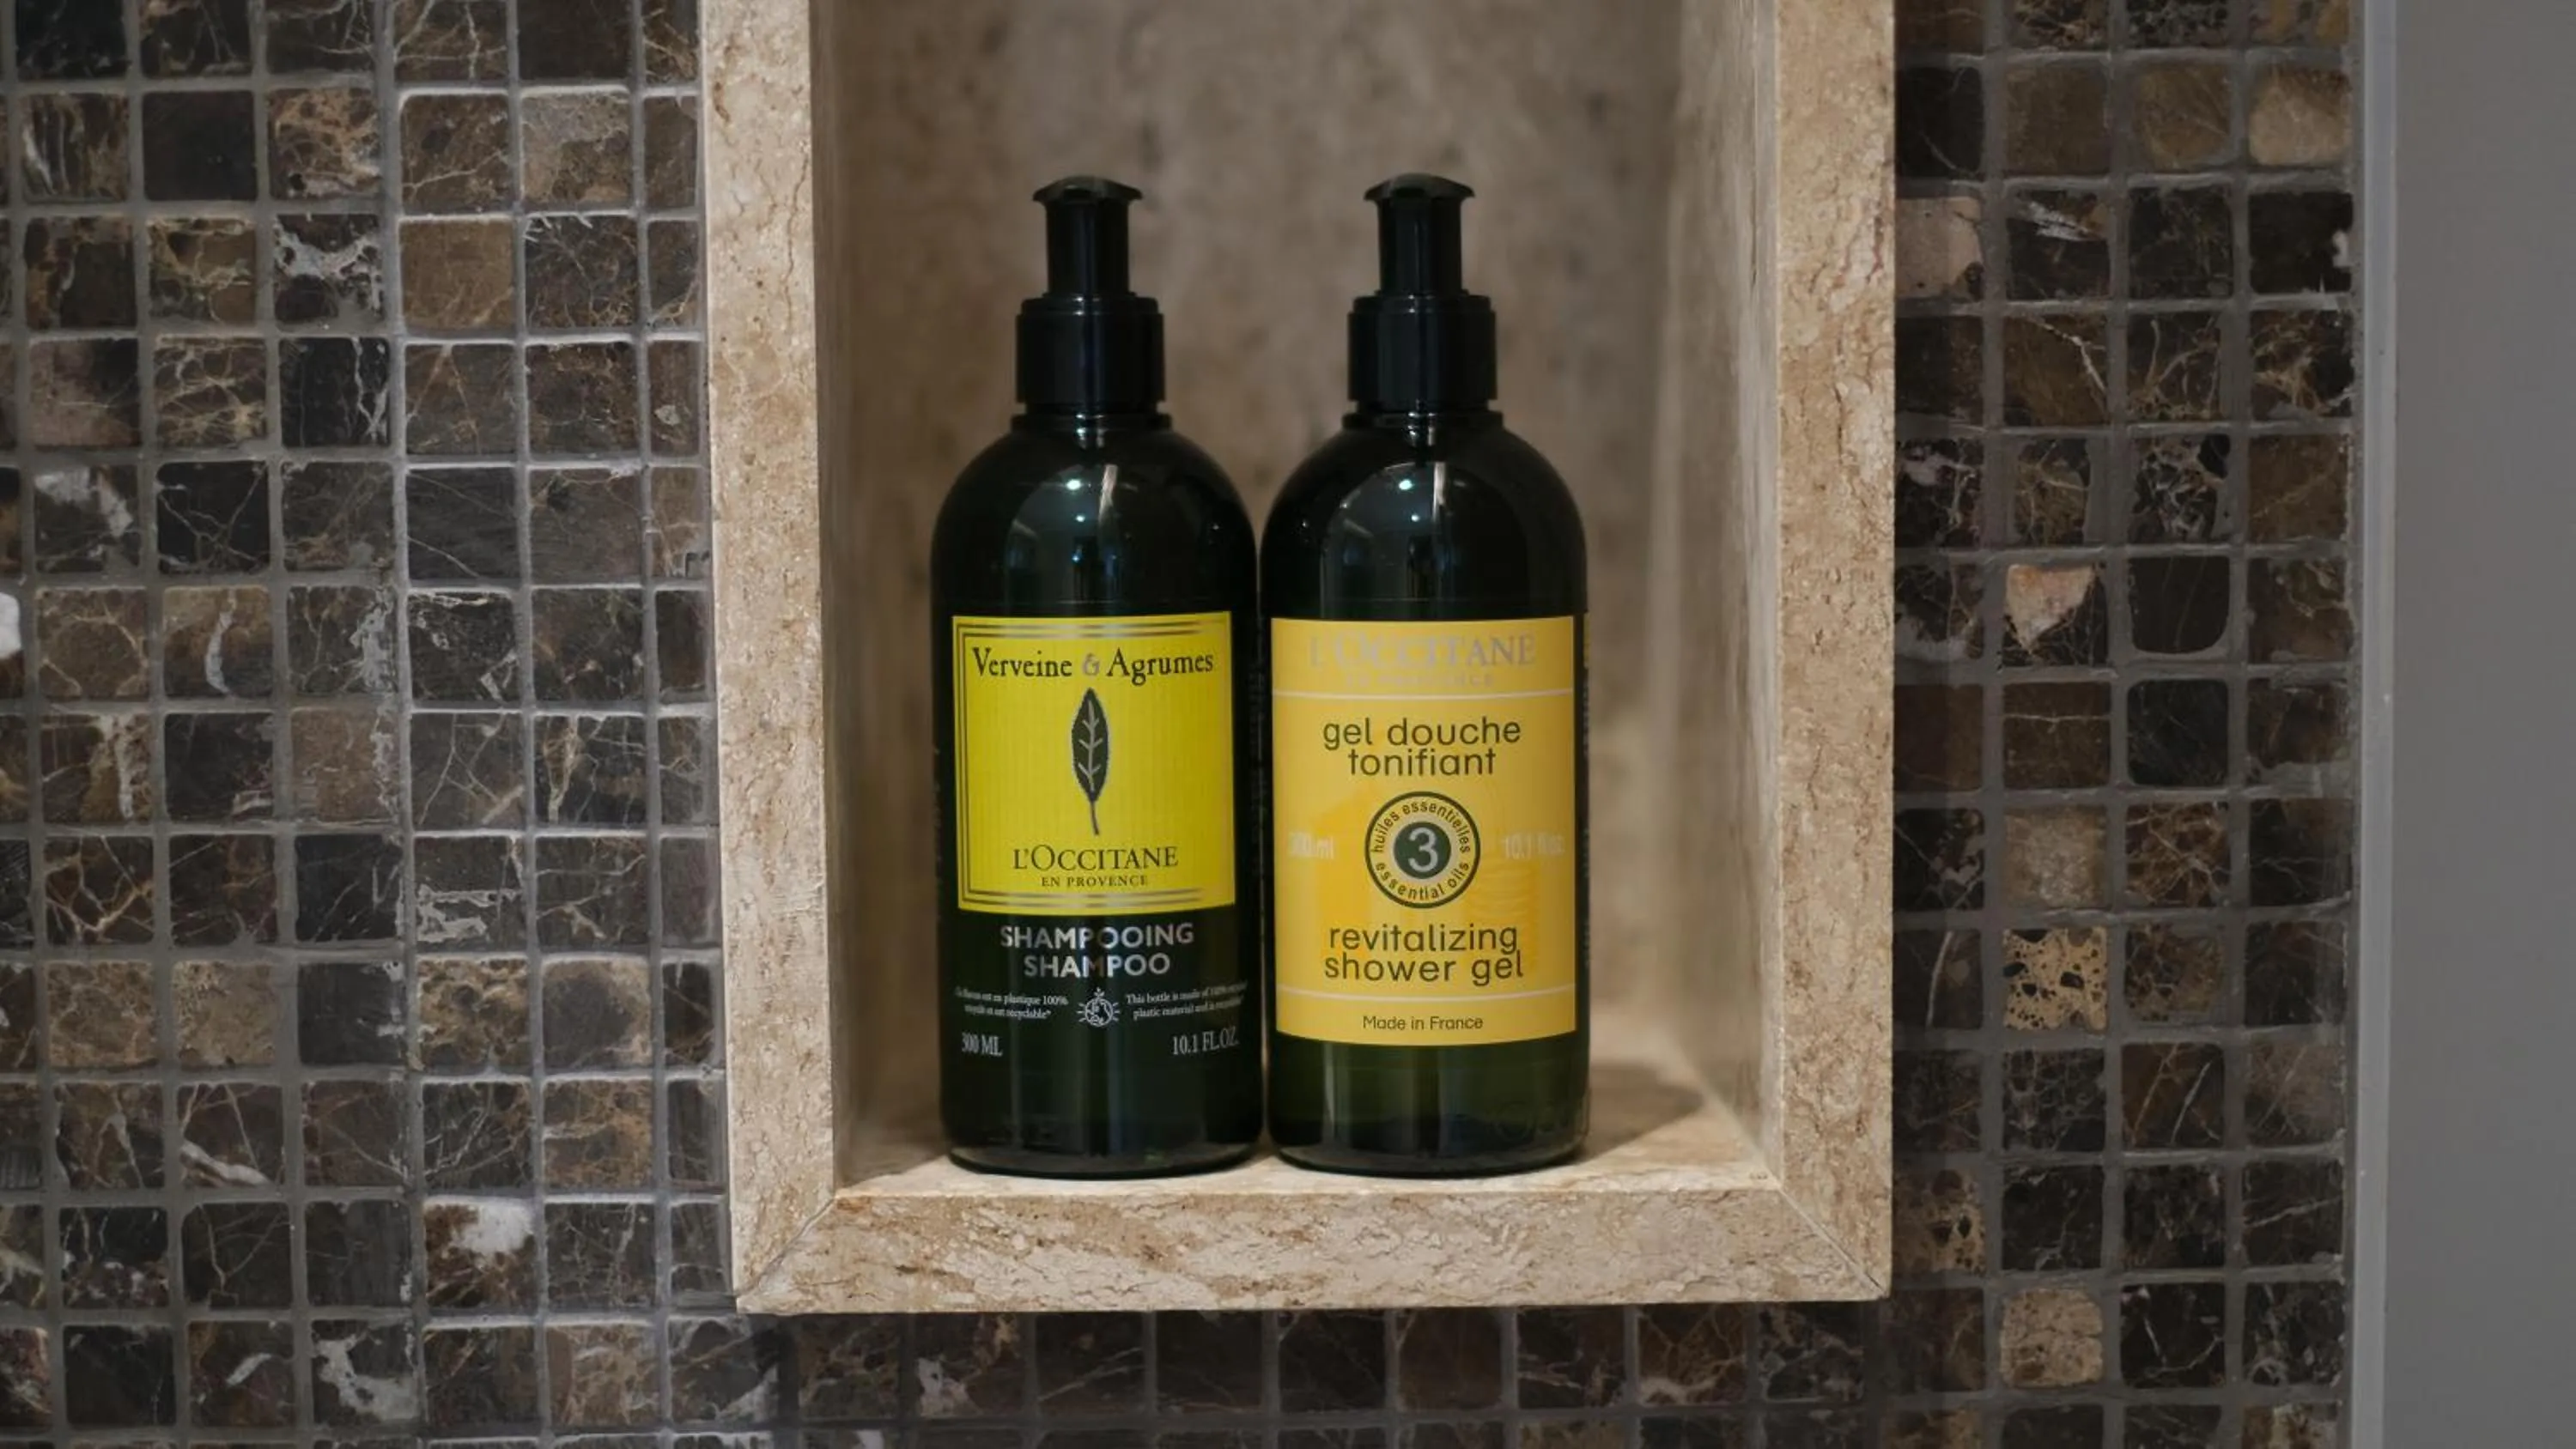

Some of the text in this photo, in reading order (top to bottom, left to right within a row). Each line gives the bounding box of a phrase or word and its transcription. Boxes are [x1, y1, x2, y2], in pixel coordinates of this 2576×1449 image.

[972, 646, 1214, 686] Verveine & Agrumes
[1323, 716, 1521, 751] gel douche
[1347, 748, 1496, 776] tonifiant
[1370, 801, 1471, 853] huiles essentielles
[1013, 844, 1179, 870] L'OCCITANE
[1409, 828, 1438, 873] 3
[1042, 875, 1148, 888] EN PROVENCE
[1376, 863, 1469, 900] essential oils
[1000, 923, 1194, 949] SHAMPOOING
[1329, 924, 1517, 955] revitalizing
[1024, 952, 1170, 979] SHAMPOO
[1324, 949, 1523, 986] shower gel
[1043, 995, 1069, 1005] 100%
[1127, 993, 1145, 1003] This
[1146, 991, 1170, 1003] bottle
[1363, 1016, 1484, 1031] Made in France
[981, 1034, 1003, 1057] ML
[1173, 1034, 1197, 1056] 10.1
